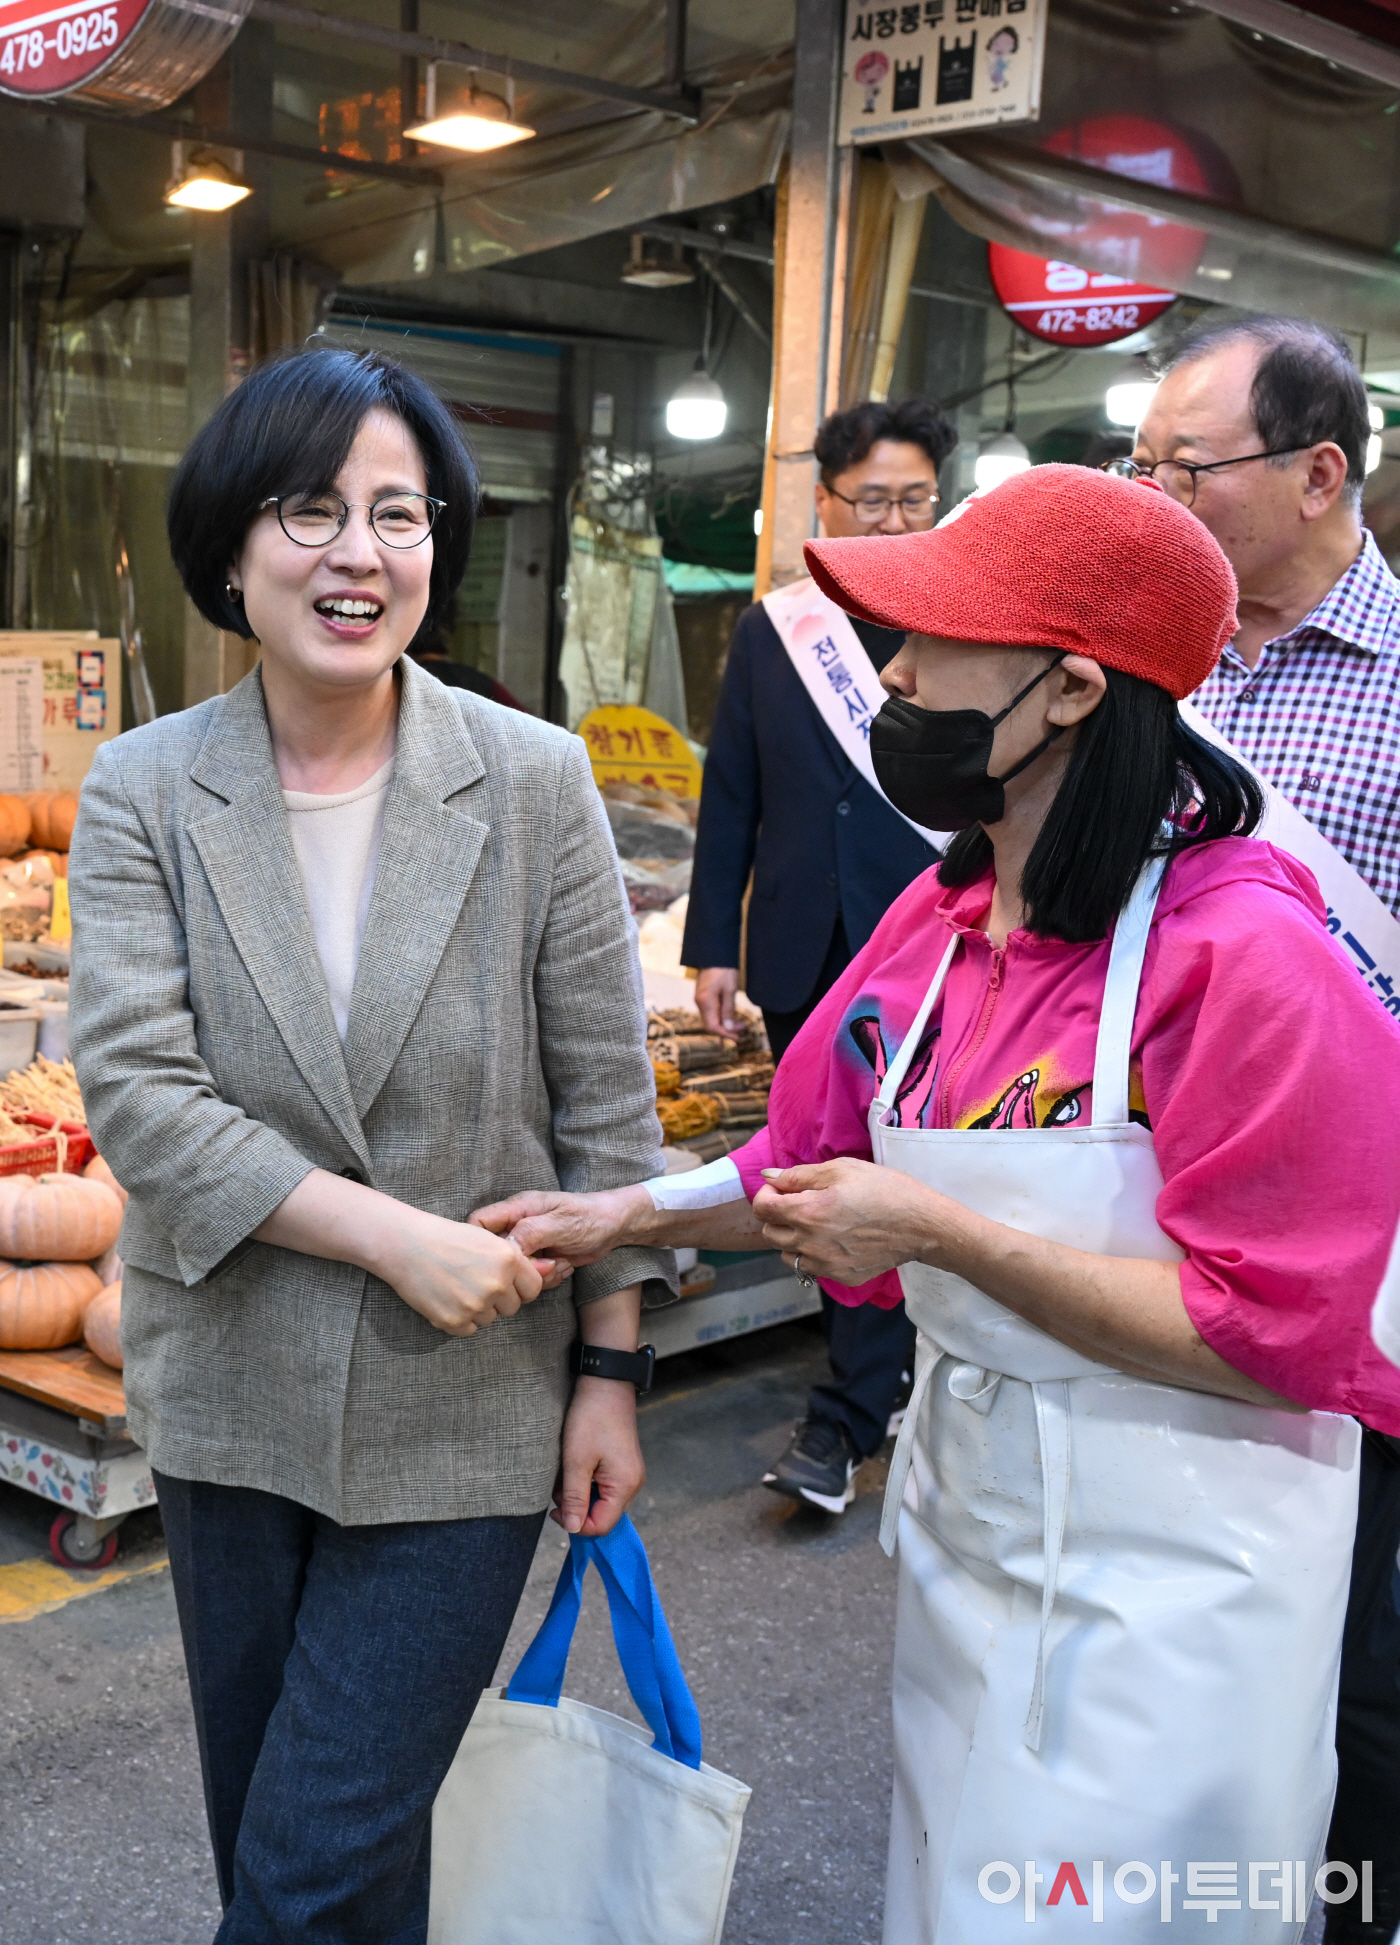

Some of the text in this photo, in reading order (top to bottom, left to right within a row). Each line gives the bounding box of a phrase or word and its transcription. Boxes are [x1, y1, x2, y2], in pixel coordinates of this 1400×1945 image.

[852, 1, 943, 41] 시장봉투
[0, 8, 118, 75] 478-0925
[1037, 305, 1139, 332] 472-8242
